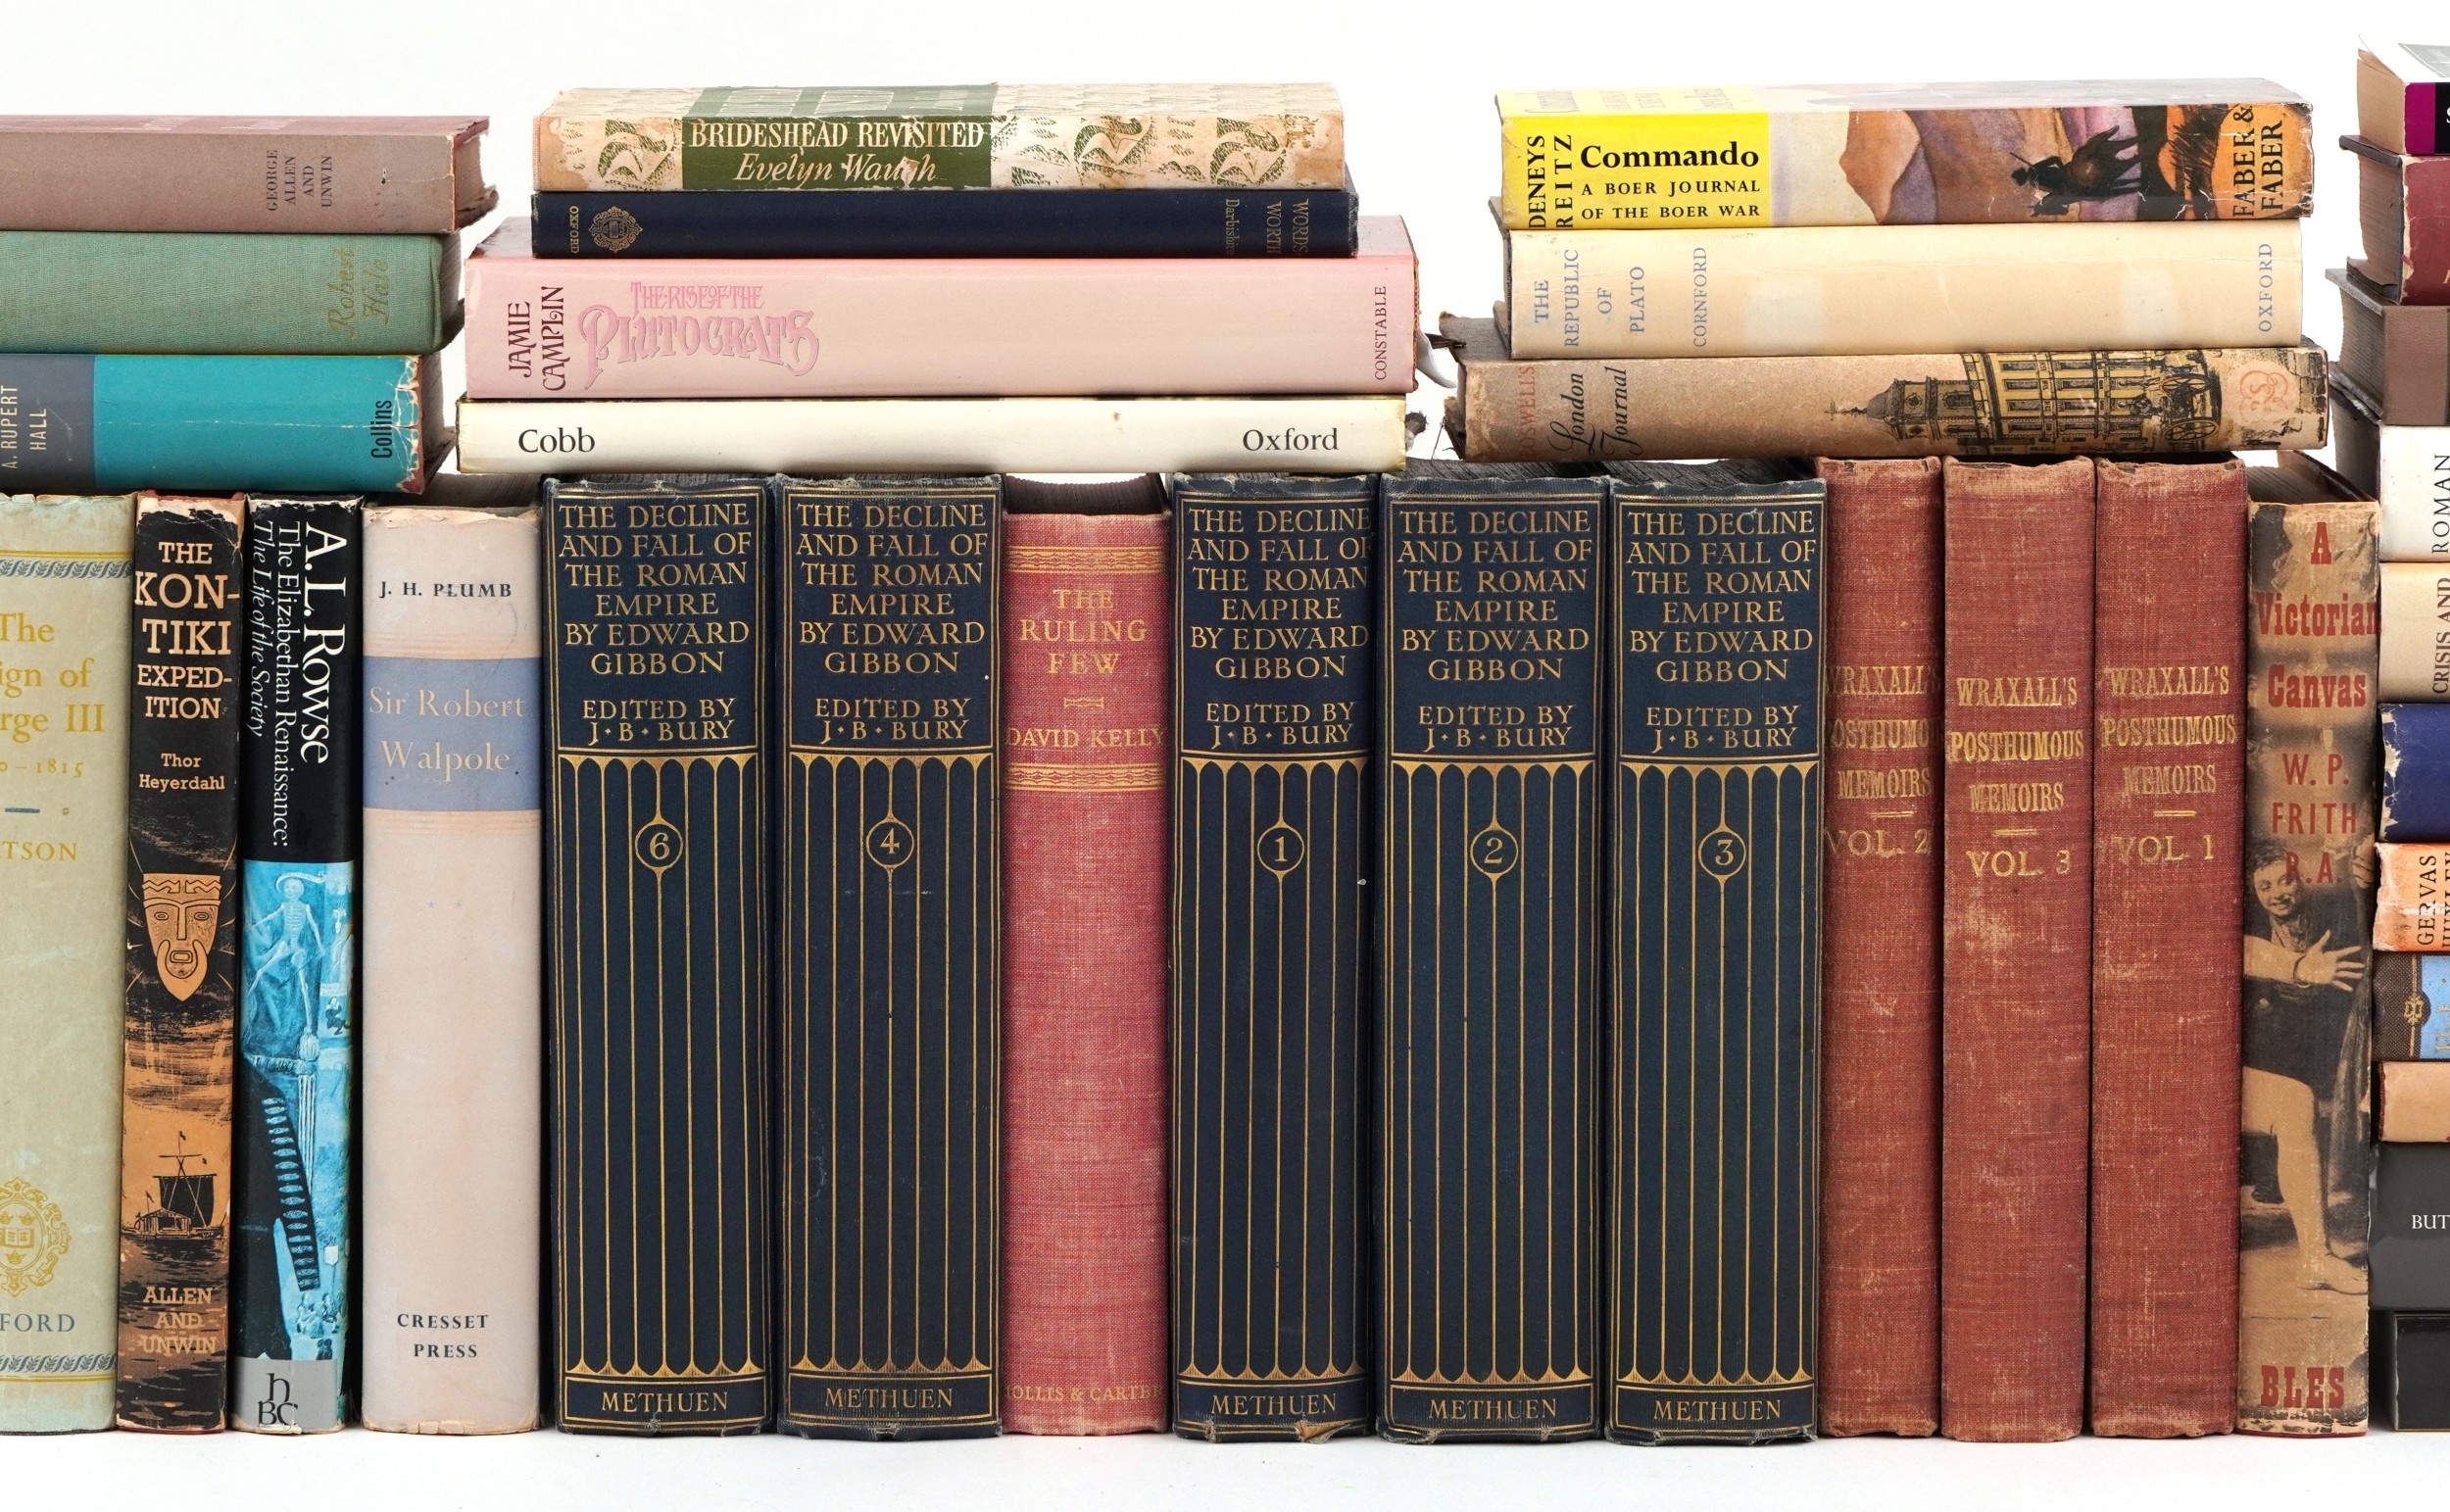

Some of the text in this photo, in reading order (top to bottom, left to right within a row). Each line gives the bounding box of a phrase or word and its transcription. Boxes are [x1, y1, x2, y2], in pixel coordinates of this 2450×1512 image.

[691, 121, 985, 148] BRIDESHEAD REVISITED
[734, 152, 937, 186] Evelyn Wauh
[1580, 142, 1759, 169] Commando
[2232, 105, 2255, 217] FABER &
[2261, 121, 2283, 210] FABER
[266, 149, 278, 212] GEORGE
[285, 155, 296, 206] ALLEN
[303, 165, 315, 197] AND
[320, 155, 332, 208] UNWIN
[1527, 134, 1546, 228] DENEYS
[1553, 134, 1574, 228] REITZ
[1581, 180, 1761, 197] A BOER JOURNAL
[1581, 205, 1761, 219] OF THE BOER WAR
[568, 205, 579, 255] OXFORD
[1265, 200, 1282, 256] WORTH
[1534, 279, 1549, 323] THE
[1564, 249, 1580, 348] REPUBLIC
[1597, 288, 1612, 315] OF
[1630, 267, 1645, 333] PLATO
[1692, 247, 1708, 348] CORNFORD
[2258, 242, 2273, 332] OXFORD
[508, 300, 532, 378] JAMIE
[540, 285, 566, 391] CAMPLIN
[1374, 285, 1387, 380] CONSTABLE
[0, 385, 19, 448] RUPERT
[1546, 372, 1596, 456] London
[1600, 365, 1644, 456] Journal
[30, 408, 47, 451] HALL
[370, 400, 392, 459] Collins
[517, 427, 596, 454] Cobb
[1242, 427, 1339, 452] Oxford
[559, 503, 750, 528] THE DECLINE
[159, 541, 213, 564] THE
[559, 532, 752, 558] AND FALL OF
[2311, 521, 2332, 564] A
[564, 561, 747, 587] THE ROMAN
[134, 570, 240, 610] KON-
[379, 581, 513, 599] J. H. PLUMB
[595, 592, 719, 616] EMPIRE
[1053, 588, 1114, 610] THE
[0, 611, 55, 643] The
[245, 520, 275, 737] The Life of the Society
[2255, 592, 2377, 637] Victorian
[142, 618, 231, 656] TIKI
[564, 620, 750, 646] BY EDWARD
[1019, 619, 1148, 642] RULING
[59, 658, 95, 688] of
[137, 663, 232, 688] EXPED-
[591, 651, 724, 675] GIBBON
[1049, 653, 1121, 674] FEW
[1215, 656, 1348, 680] GIBBON
[1656, 658, 1789, 683] GIBBON
[272, 520, 302, 847] The Elizabethan Renaissance:
[300, 623, 346, 764] Rowse
[1957, 677, 2078, 707] WRAXALL'S
[2104, 665, 2230, 697] WRAXALL'S
[2268, 663, 2367, 708] Canvas
[145, 695, 221, 719] ITION
[369, 686, 525, 717] Sir Robert
[582, 697, 736, 720] EDITED BY
[65, 704, 105, 733] III
[2101, 714, 2236, 747] POSTHUMOUS
[1005, 727, 1165, 748] DAVID KELLY
[1950, 729, 2084, 761] POSTHUMOUS
[161, 753, 201, 768] Thor
[381, 740, 511, 782] Walpole
[2281, 753, 2349, 785] W. P.
[139, 774, 225, 792] Heyerdahl
[1838, 767, 1934, 800] MEMOIRS
[2123, 763, 2216, 796] MEMOIRS
[1970, 782, 2065, 813] MEMOIRS
[2272, 802, 2357, 835] FRITH
[0, 841, 77, 861] TSON
[650, 831, 670, 860] 6
[879, 827, 901, 855] 4
[1274, 836, 1290, 862] 1
[1484, 837, 1504, 864] 2
[1714, 839, 1735, 866] 3
[1914, 829, 1930, 855] 2
[2205, 834, 2214, 859] 1
[2056, 850, 2071, 874] 3
[2417, 855, 2437, 946] GERVAS
[143, 1285, 213, 1305] ALLEN
[154, 1311, 205, 1330] AND
[397, 1313, 489, 1329] CRESSET
[139, 1335, 218, 1356] UNWIN
[414, 1343, 477, 1358] PRESS
[824, 1388, 954, 1410] METHUEN
[2261, 1364, 2344, 1408] BLES
[602, 1391, 729, 1413] METHUEN
[1211, 1392, 1339, 1417] METHUEN
[1430, 1398, 1557, 1421] METHUEN
[1654, 1399, 1782, 1421] METHUEN
